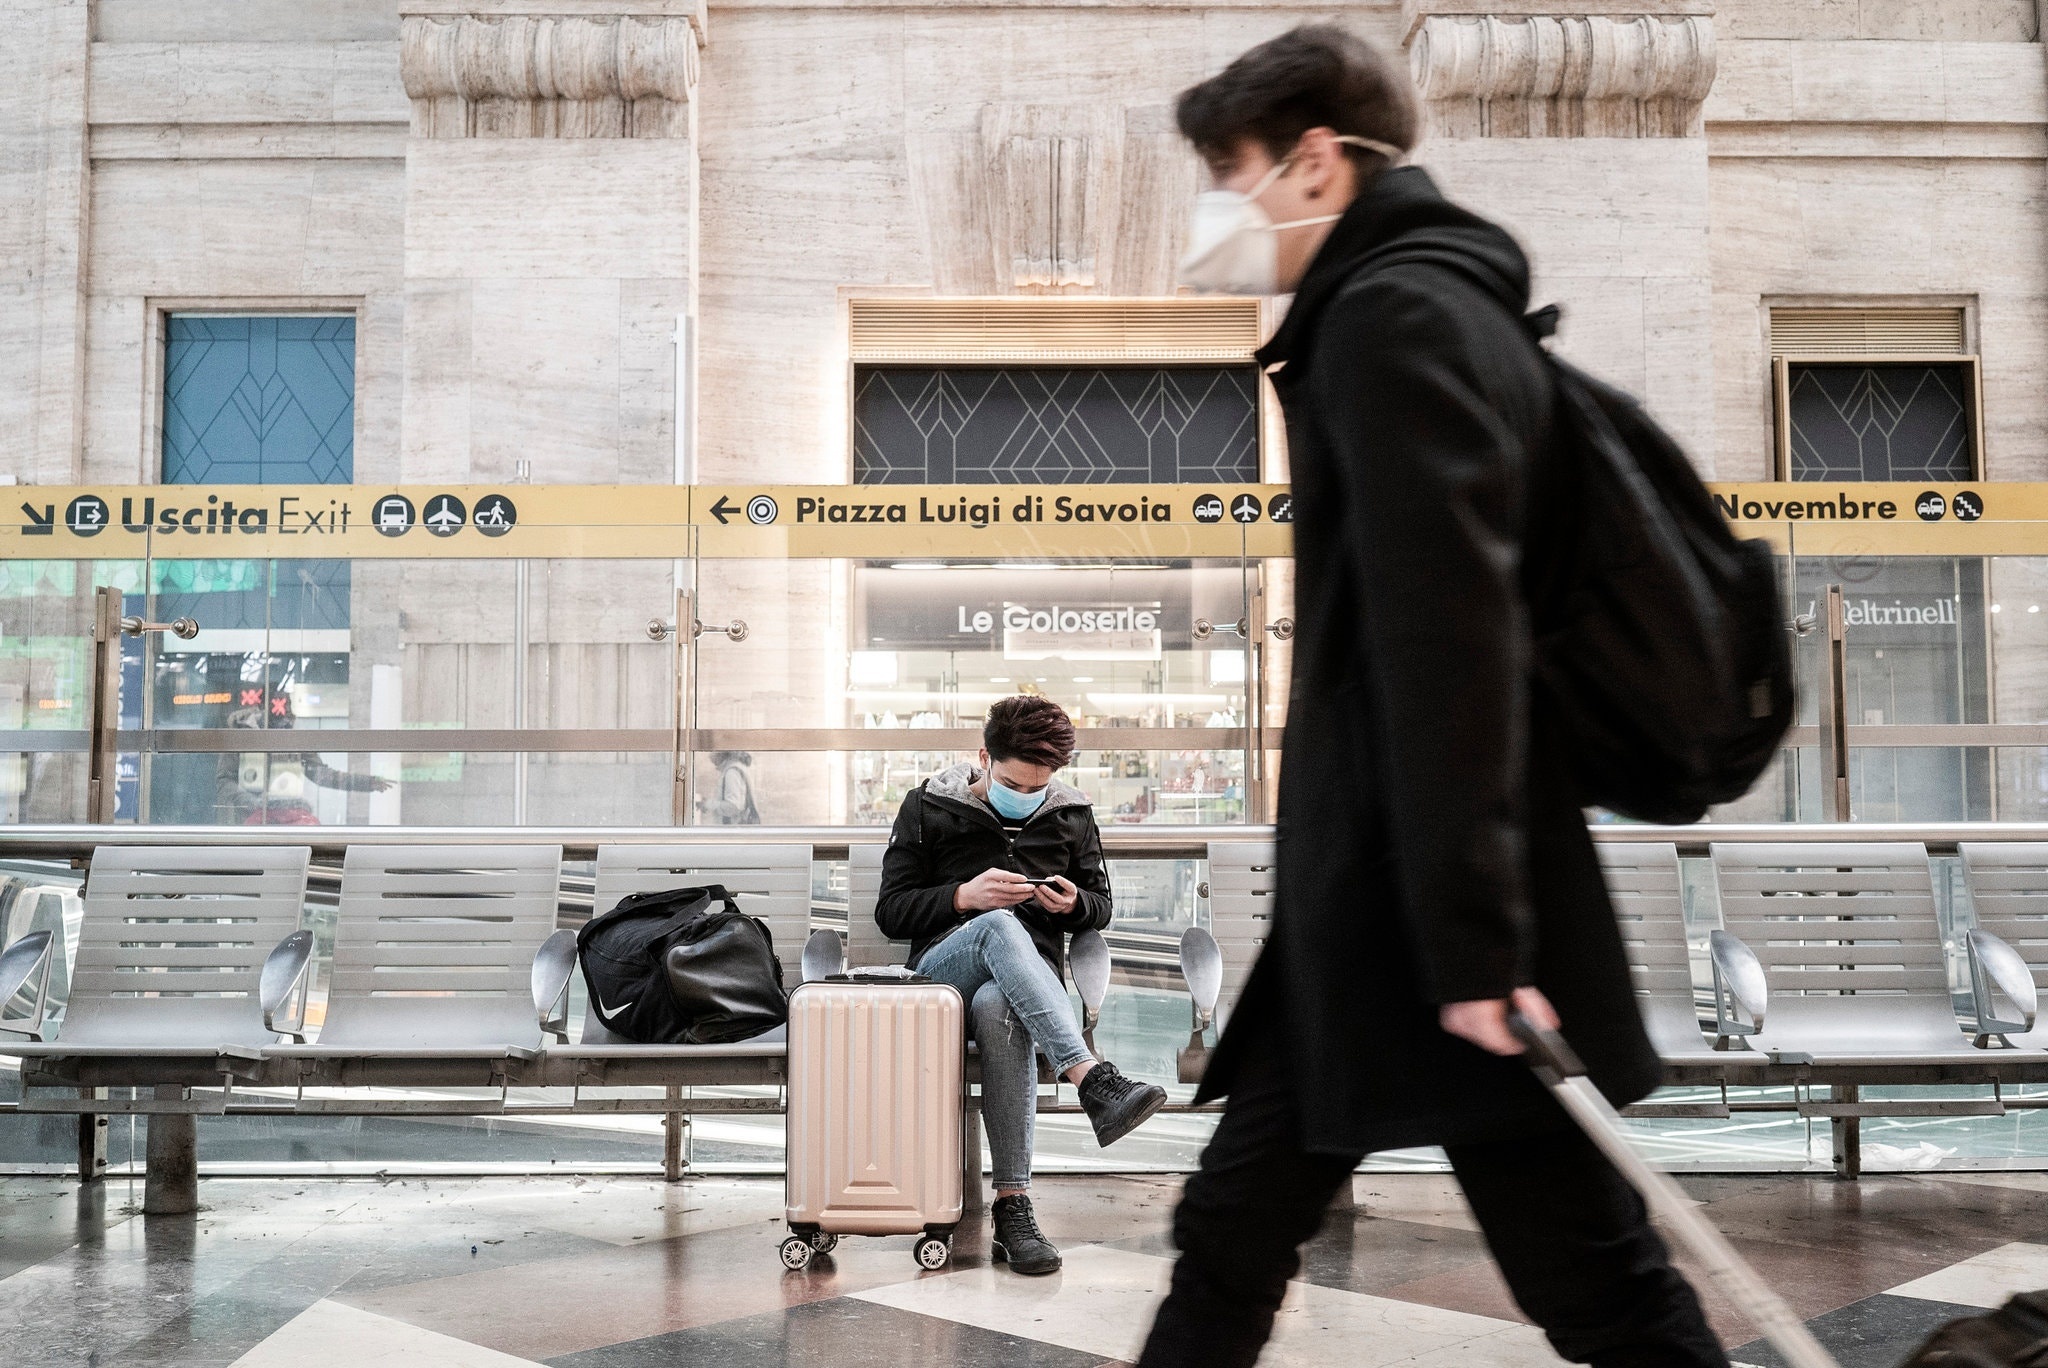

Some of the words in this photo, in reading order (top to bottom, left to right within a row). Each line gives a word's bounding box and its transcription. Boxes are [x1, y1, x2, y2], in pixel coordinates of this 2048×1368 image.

[122, 494, 268, 534] Uscita
[278, 497, 351, 534] Exit
[797, 497, 906, 523] Piazza
[920, 496, 1000, 528] Luigi
[1012, 495, 1043, 522] di
[1055, 496, 1171, 522] Savoia
[1713, 492, 1897, 519] Novembre
[958, 606, 993, 633] Le
[1002, 605, 1156, 633] Goloserie
[1843, 599, 1957, 625] eltrinell
